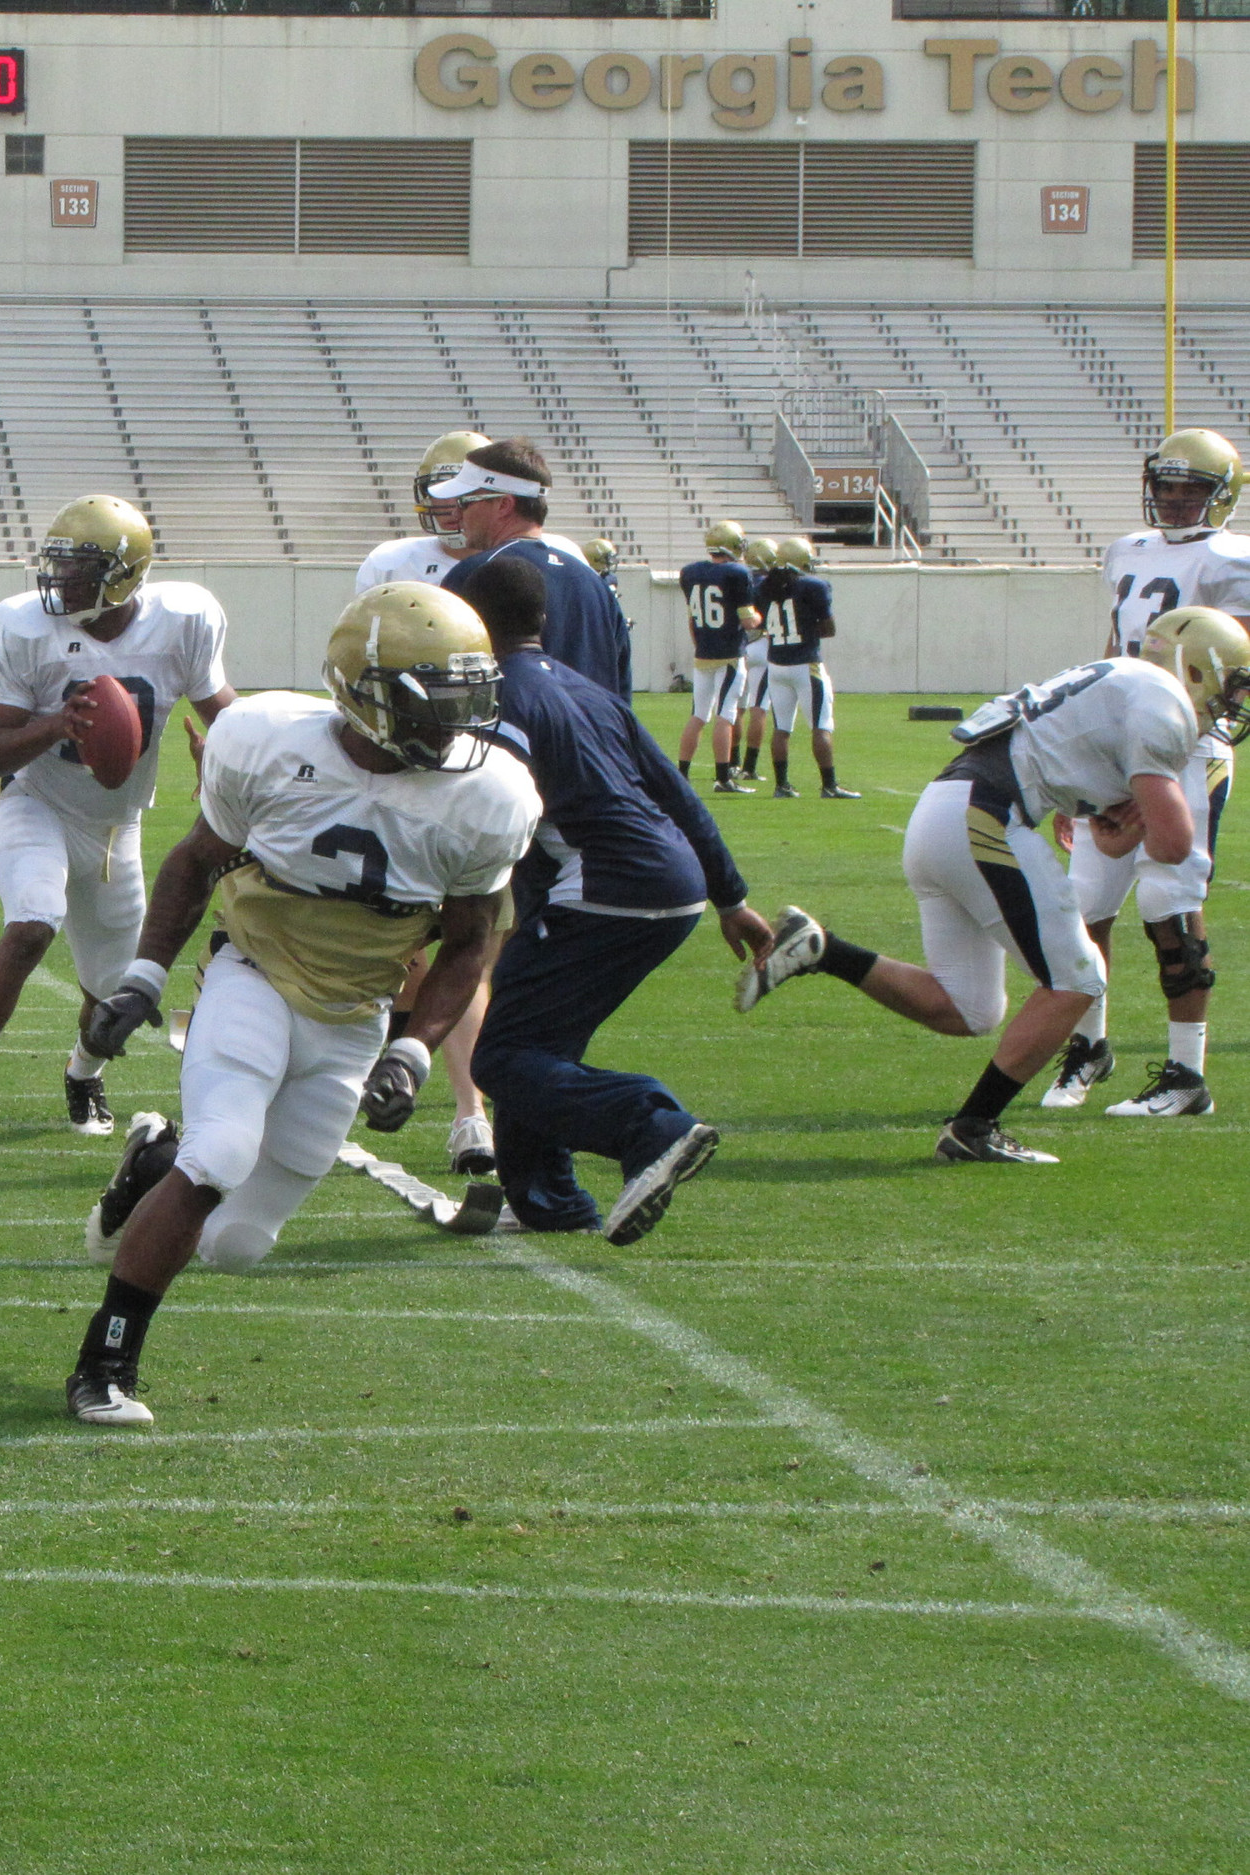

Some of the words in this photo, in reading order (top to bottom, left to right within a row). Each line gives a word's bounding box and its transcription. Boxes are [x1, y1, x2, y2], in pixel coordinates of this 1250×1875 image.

[414, 33, 886, 129] Georgia
[923, 39, 1197, 113] Tech
[59, 197, 90, 216] 133
[1049, 203, 1080, 222] 134
[689, 584, 725, 629] 46
[766, 598, 802, 646] 41
[311, 823, 388, 899] 3
